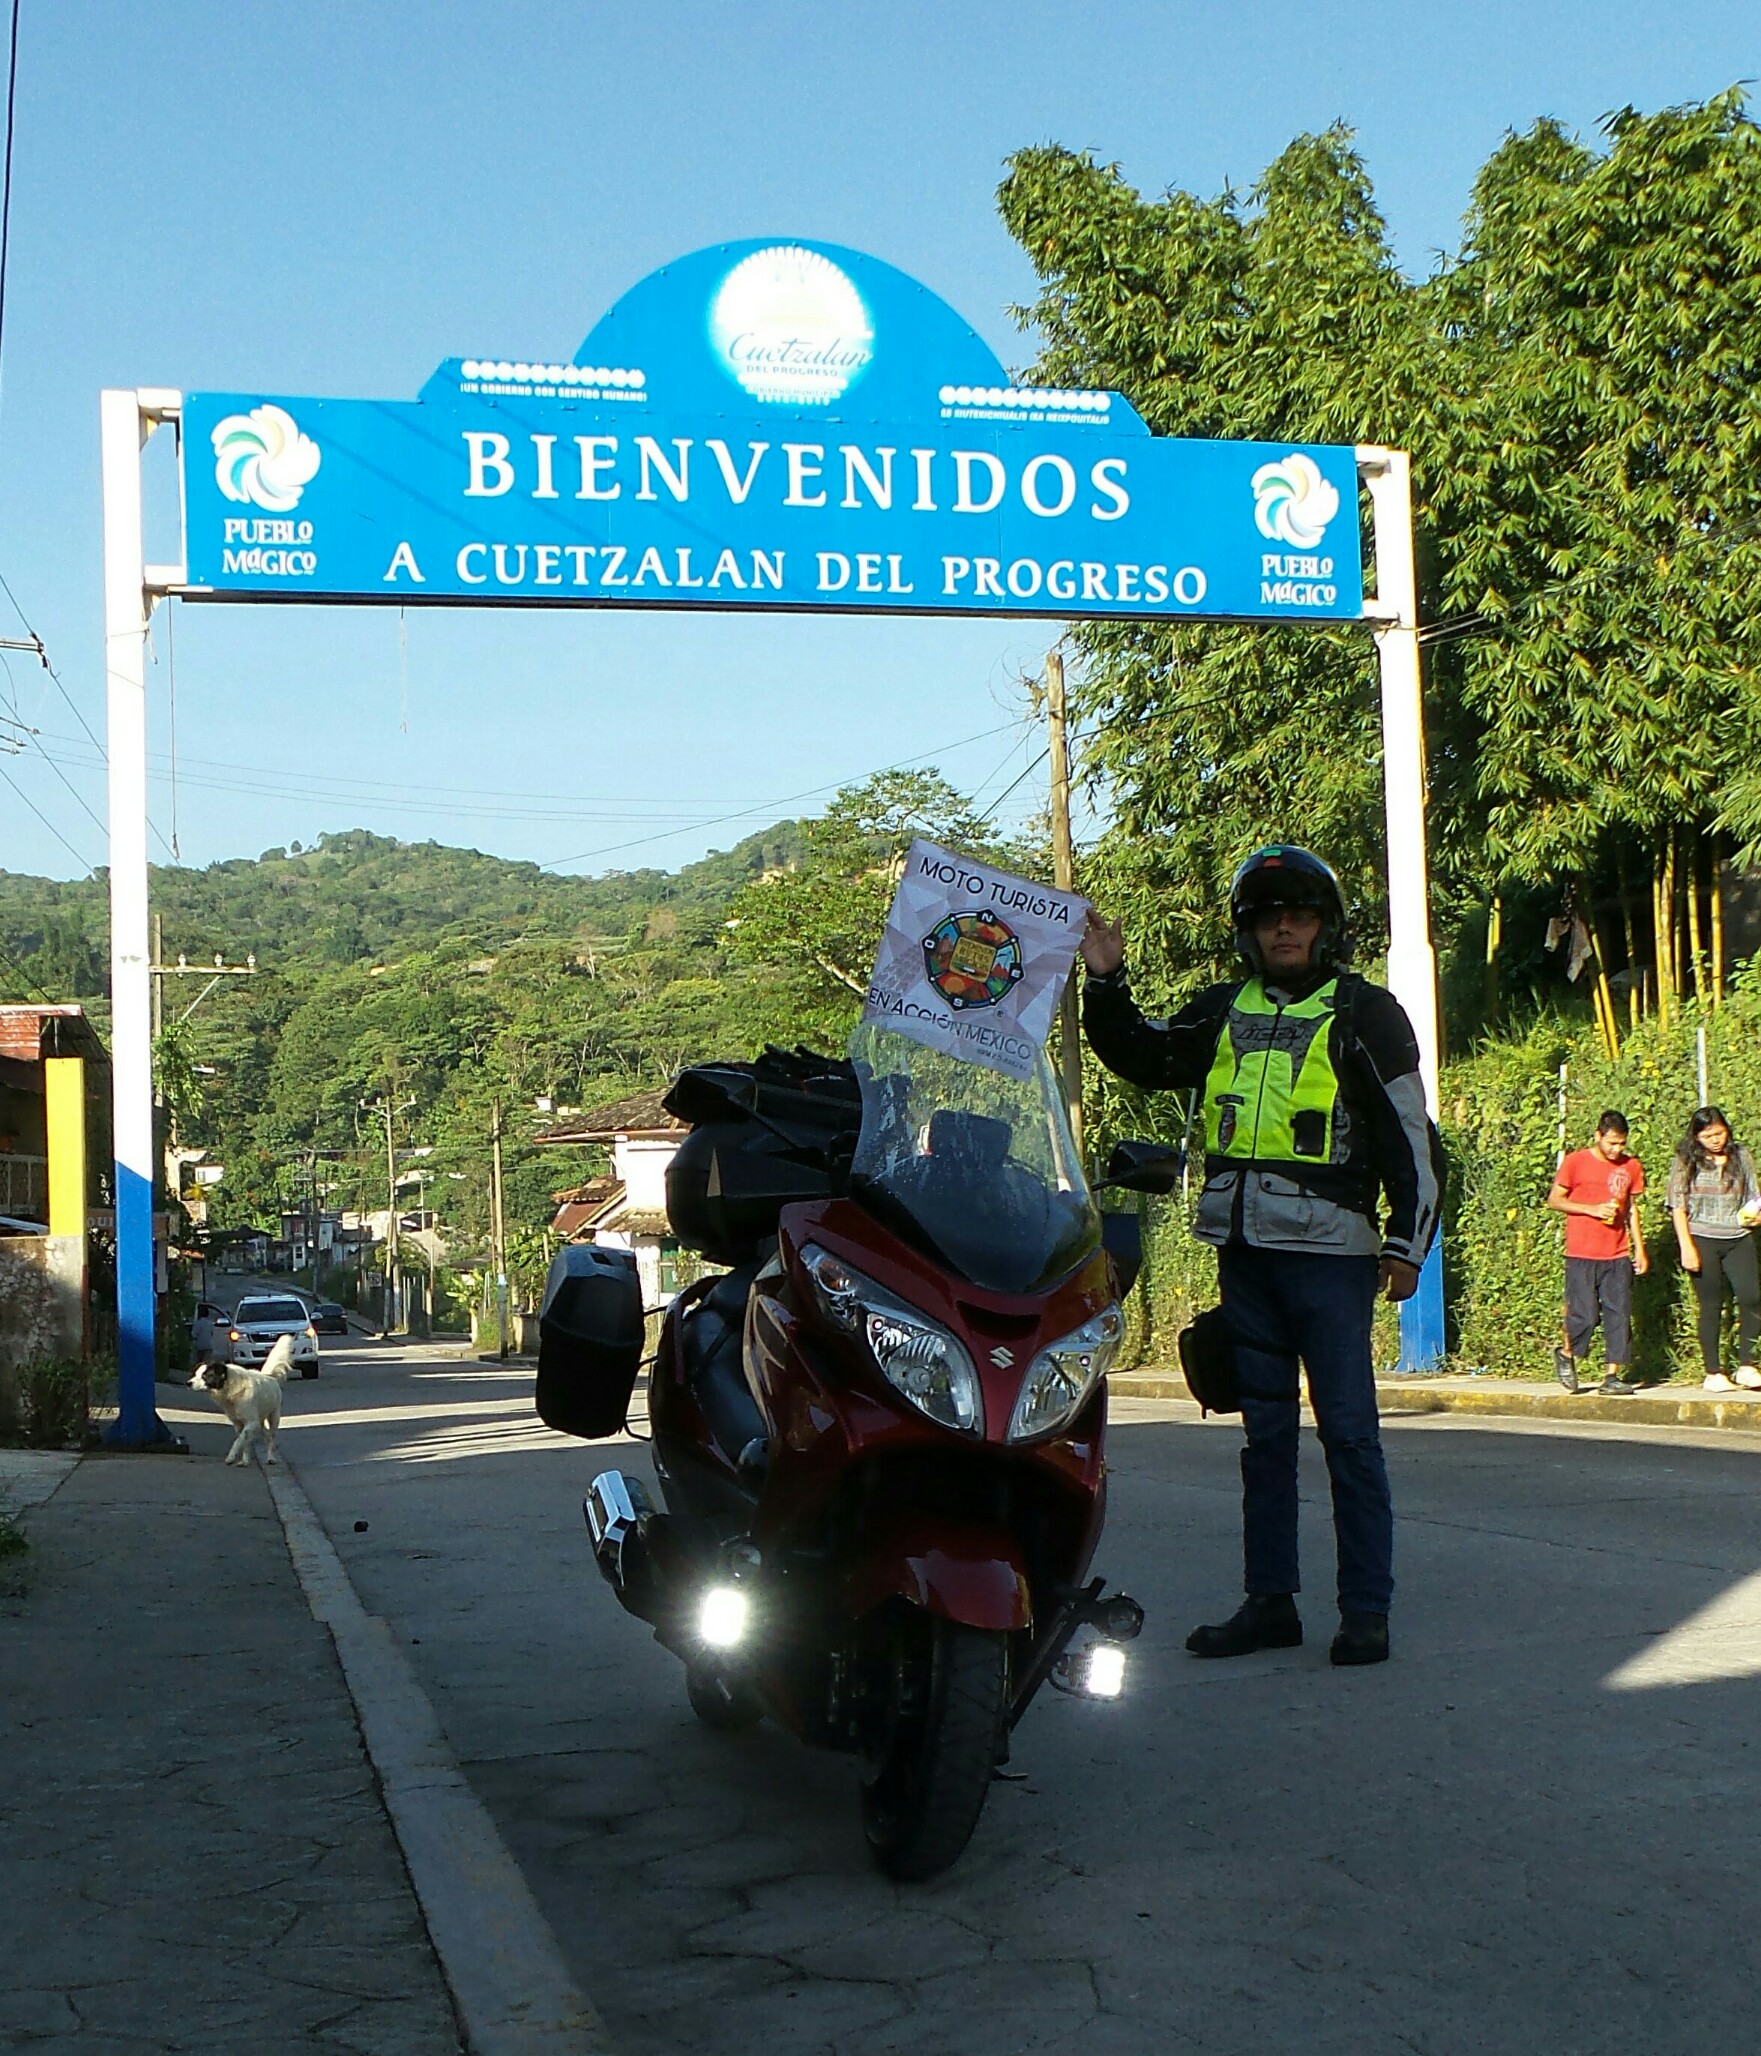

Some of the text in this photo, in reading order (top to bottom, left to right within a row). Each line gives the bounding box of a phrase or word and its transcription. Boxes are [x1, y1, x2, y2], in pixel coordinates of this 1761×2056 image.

[729, 332, 871, 368] Cuetzalan
[747, 365, 838, 377] DEL PROGRESO
[462, 432, 1130, 521] BIENVENIDOS
[224, 518, 314, 545] PUEBLO
[384, 541, 1207, 605] A CUETZALAN DEL PROGRESO
[1261, 553, 1334, 579] PUEBLO
[919, 856, 1070, 924] MOTO TURISTA
[868, 986, 891, 1010] EN
[891, 998, 962, 1037] ACCIÓN
